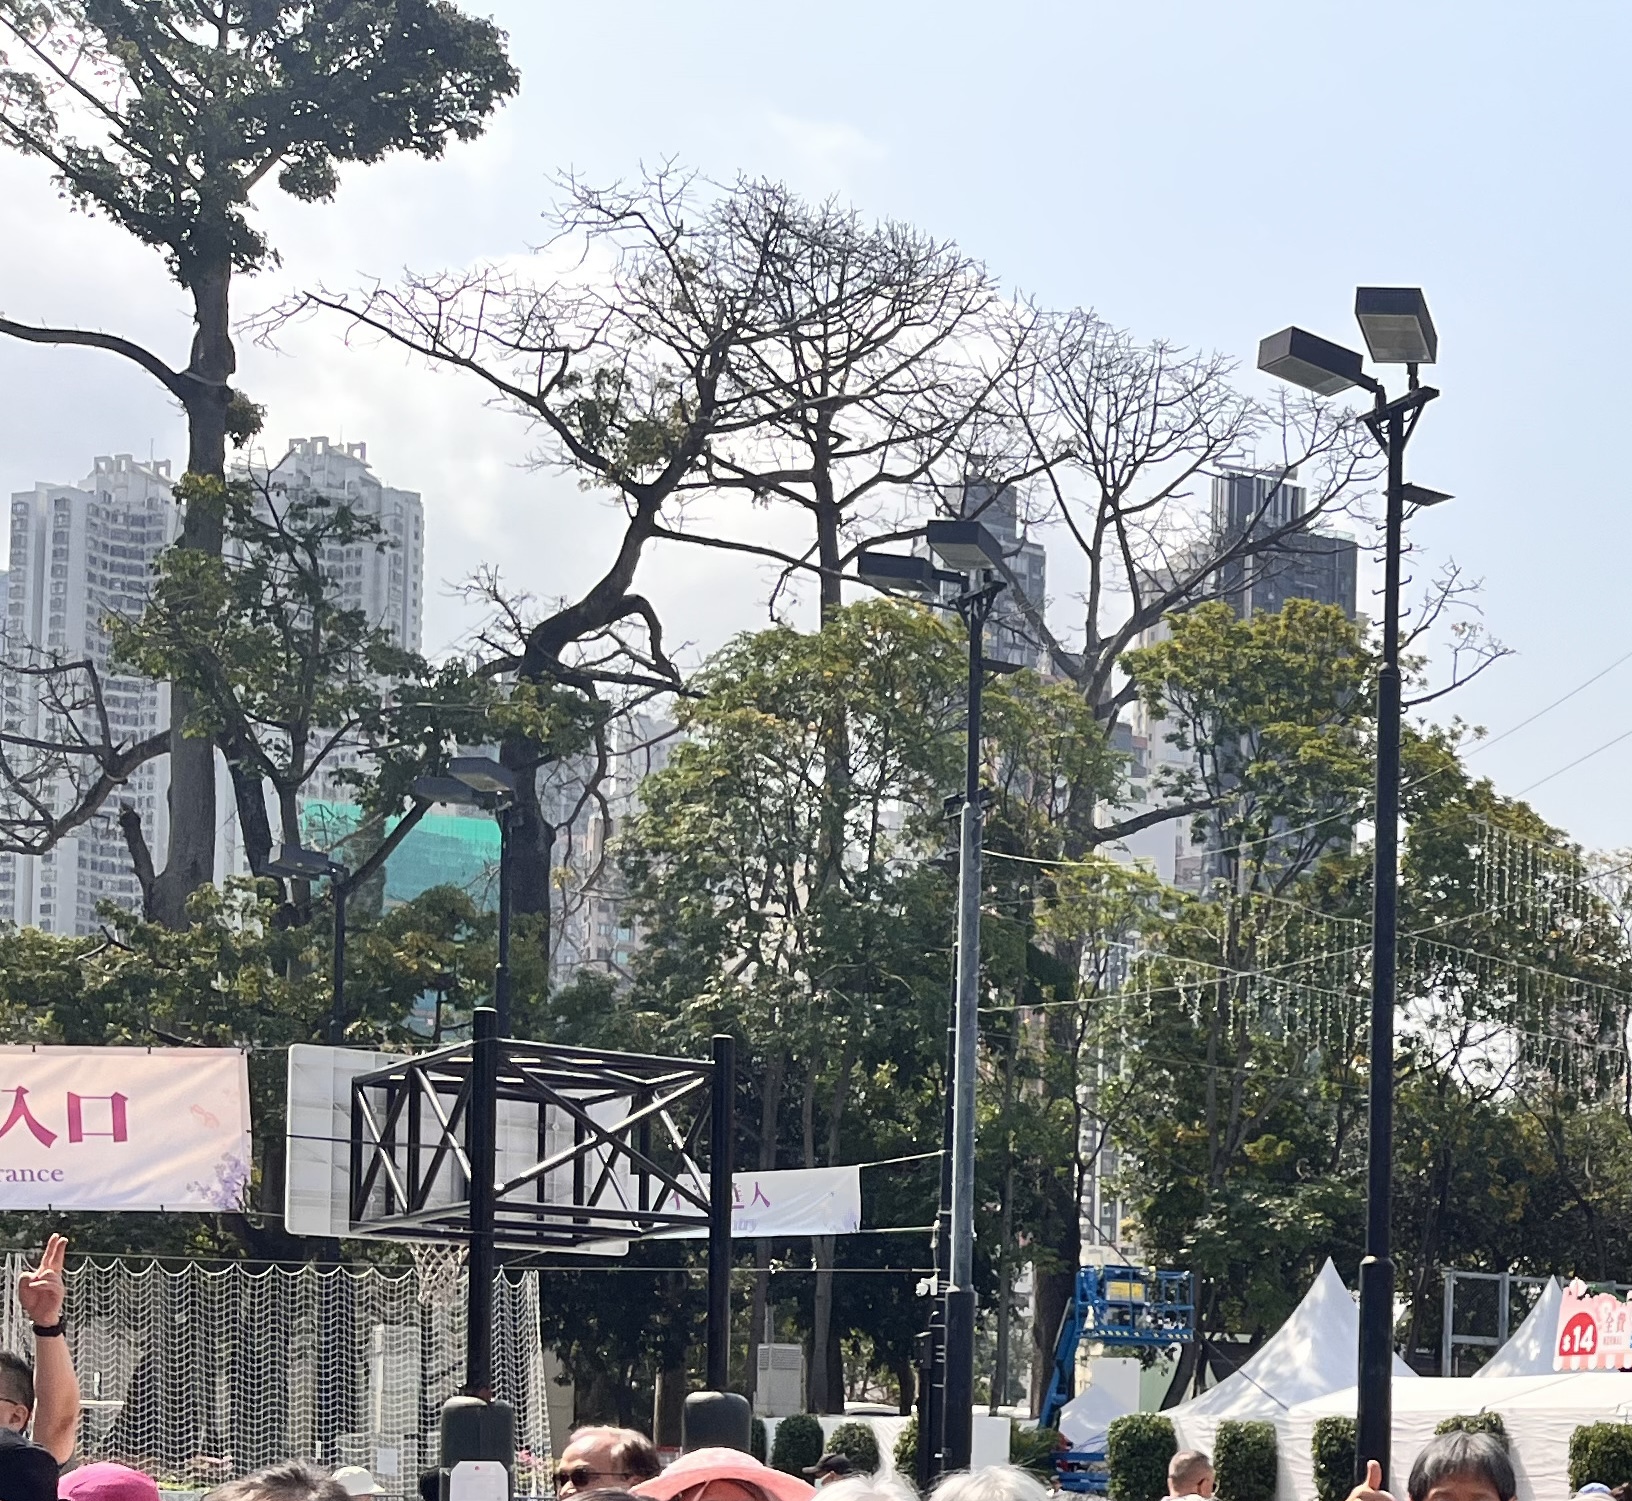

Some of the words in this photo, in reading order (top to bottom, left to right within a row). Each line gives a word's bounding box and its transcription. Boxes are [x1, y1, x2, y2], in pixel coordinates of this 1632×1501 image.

[0, 1085, 128, 1149] 入口
[1605, 1311, 1626, 1334] 全費
[1562, 1324, 1594, 1353] $14
